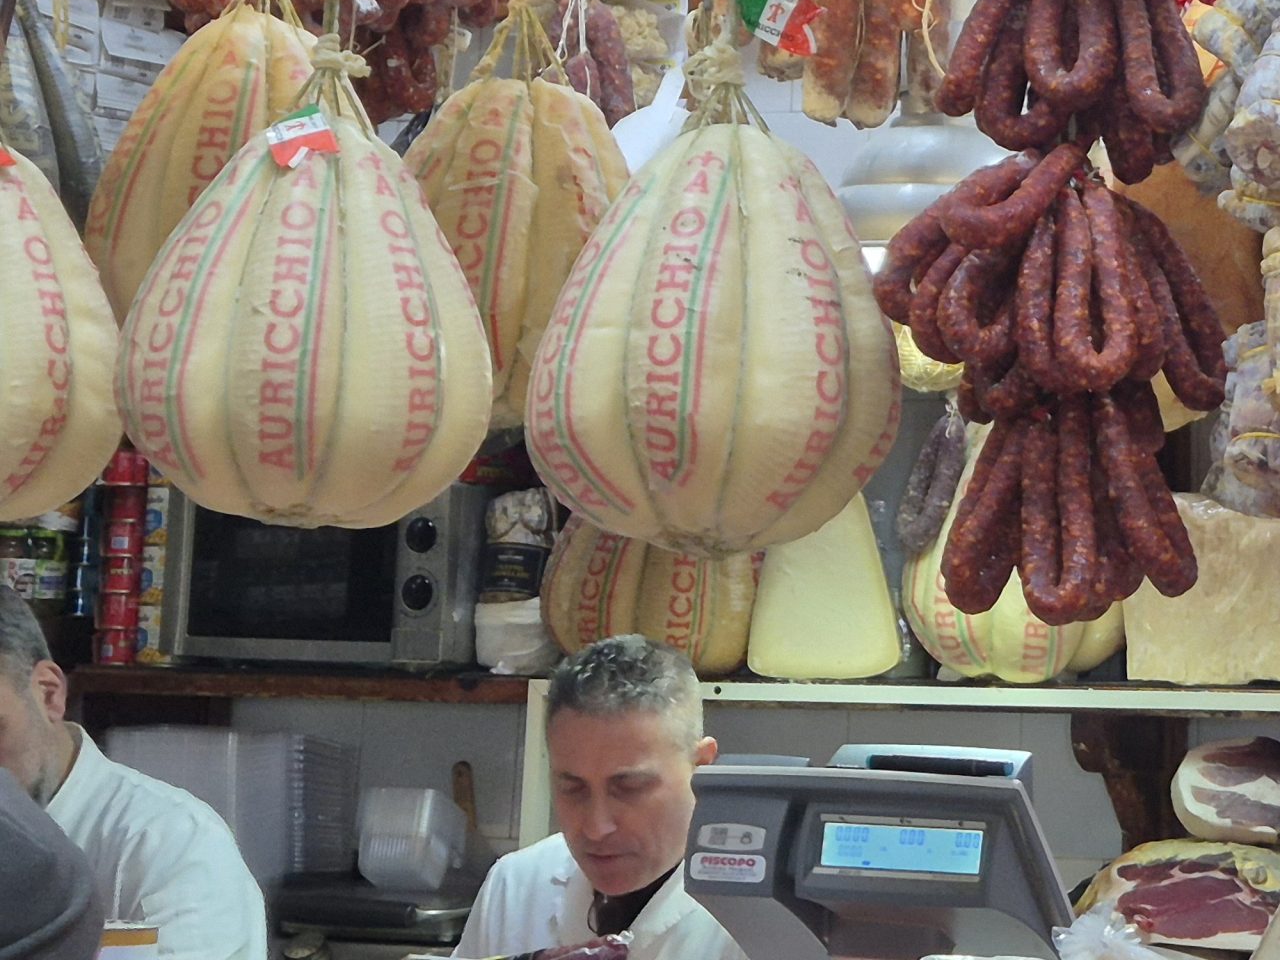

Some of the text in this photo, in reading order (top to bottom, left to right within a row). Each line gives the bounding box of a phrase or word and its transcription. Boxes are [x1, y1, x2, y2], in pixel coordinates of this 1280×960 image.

[187, 80, 238, 208] CHIO
[454, 139, 500, 287] CCHIO
[139, 199, 223, 472] AURICCHIO
[258, 200, 317, 472] AURICCHIO
[381, 209, 440, 473] AURICCHIO
[646, 206, 707, 482] AURICCHIO
[1019, 610, 1049, 676] AUR
[700, 855, 757, 868] PISCOPO
